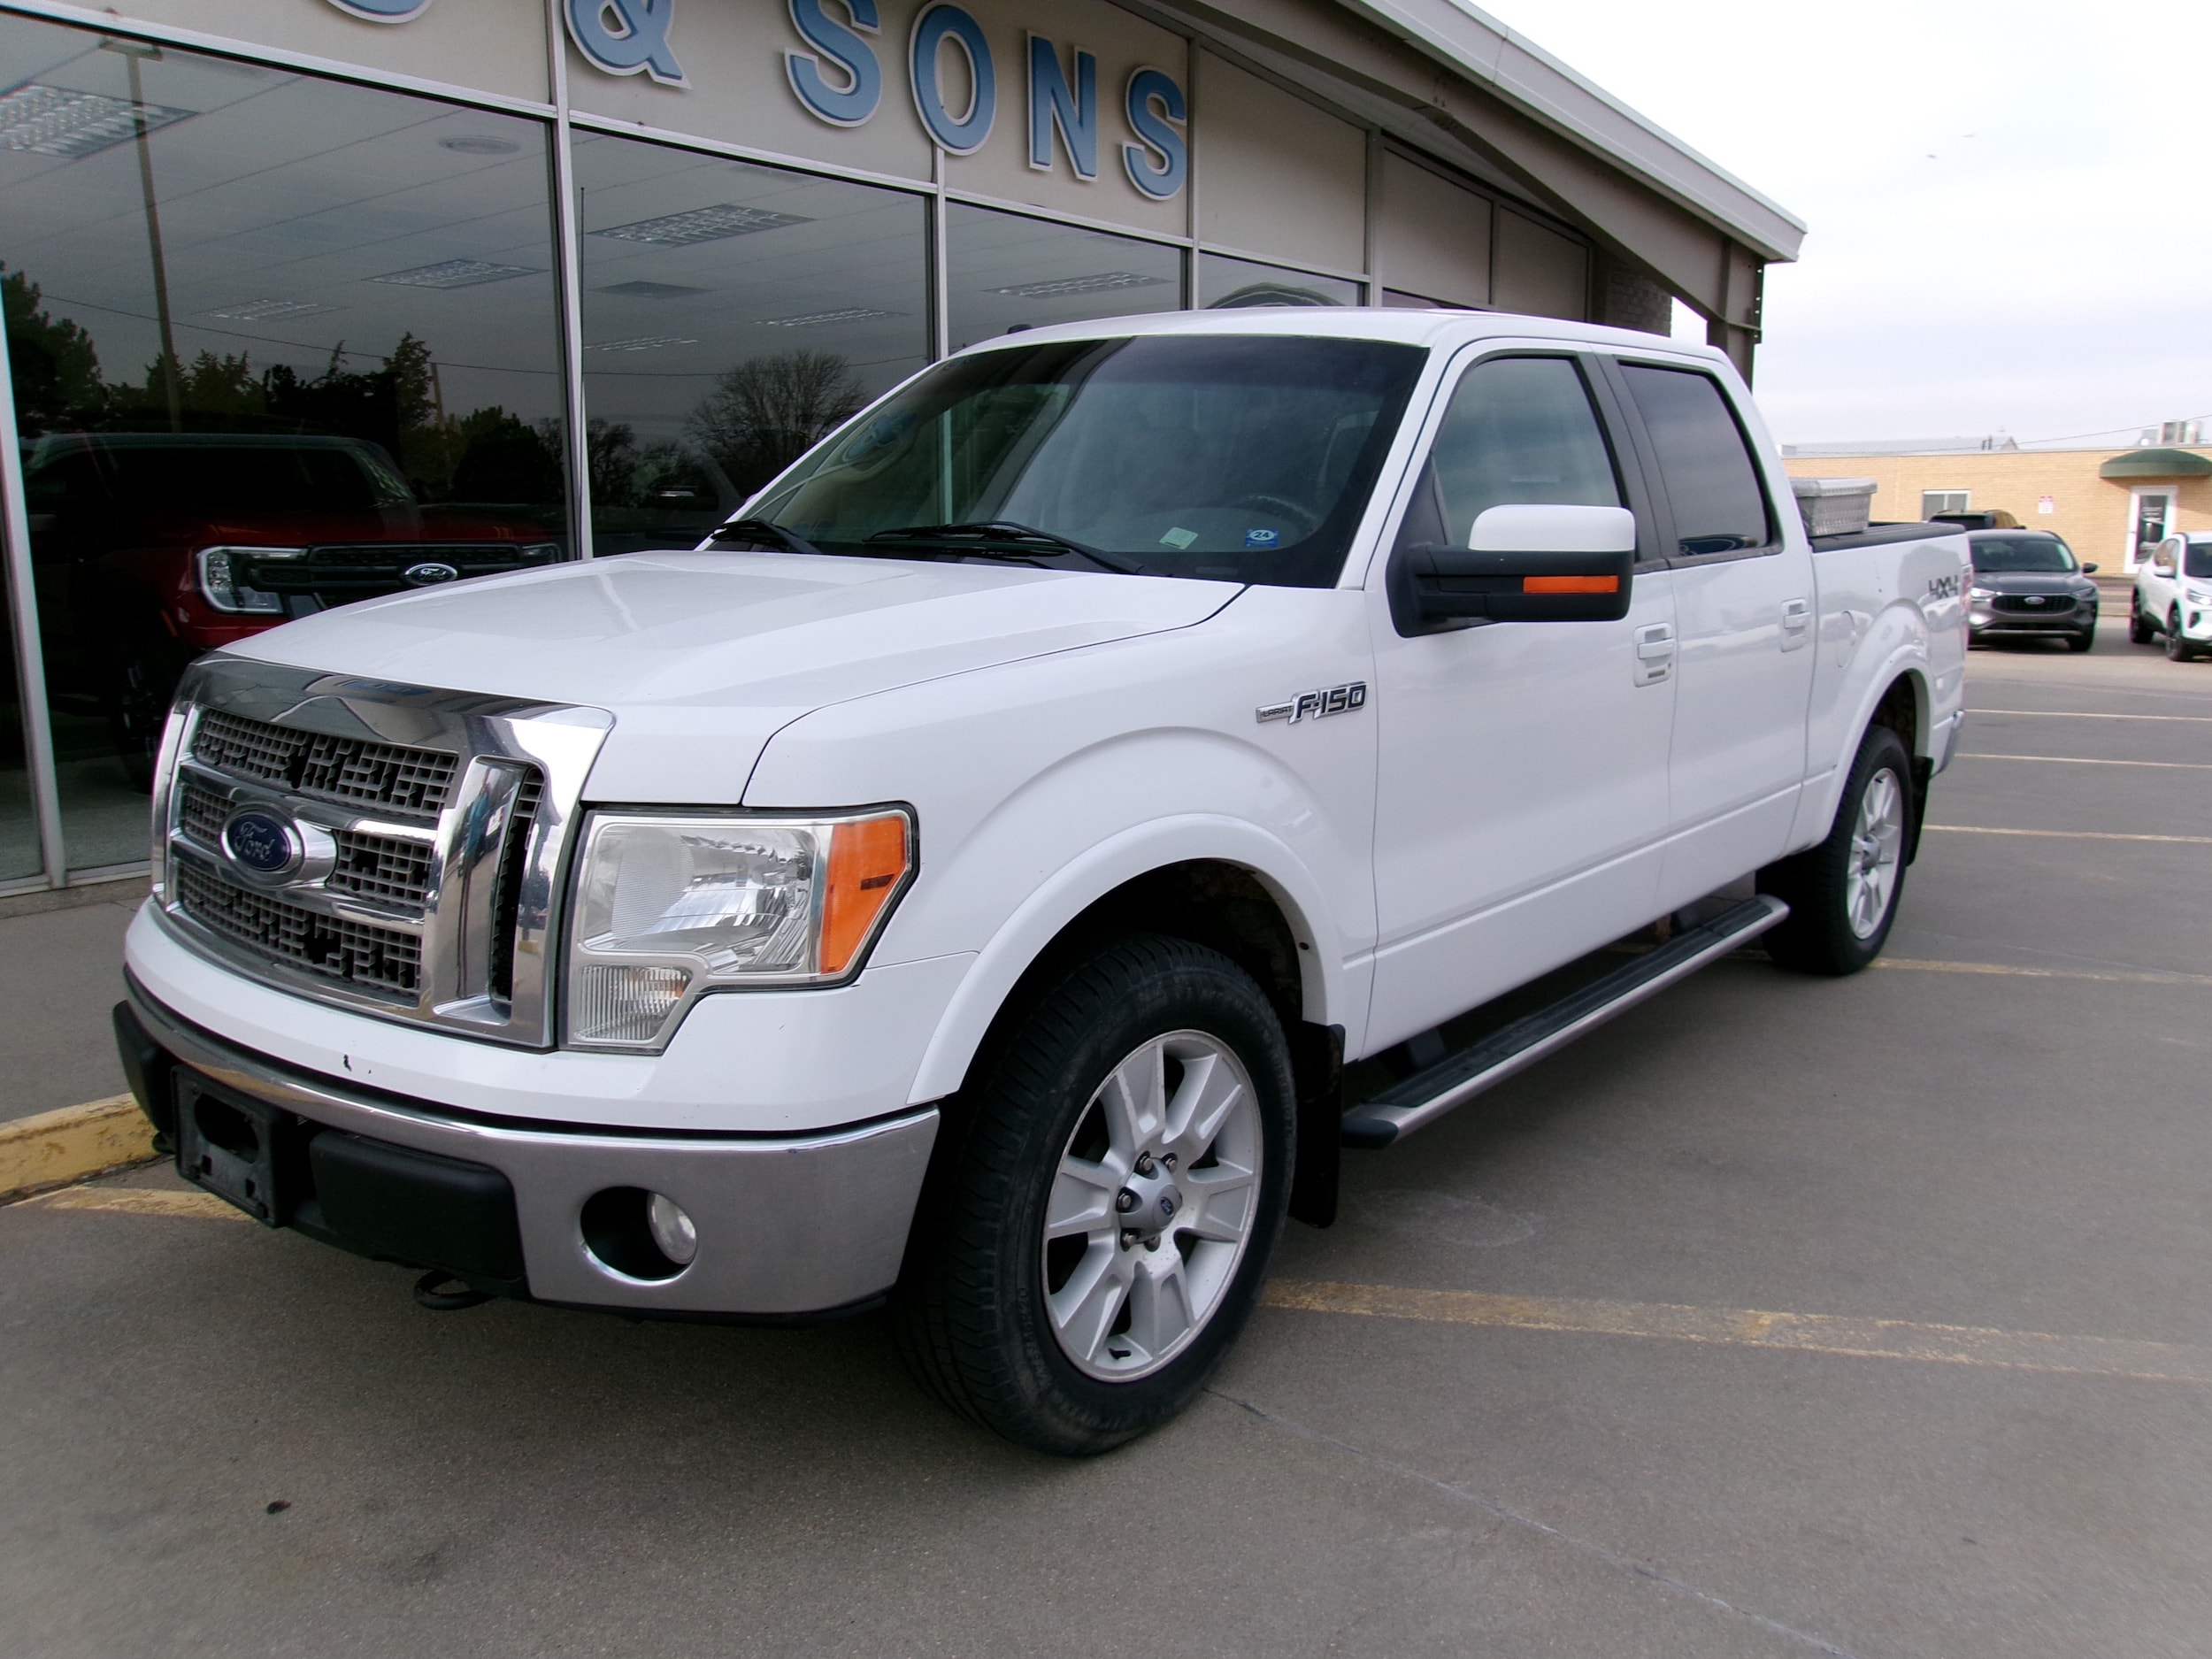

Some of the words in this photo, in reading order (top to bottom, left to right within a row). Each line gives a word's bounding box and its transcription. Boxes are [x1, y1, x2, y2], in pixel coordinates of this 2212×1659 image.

[785, 0, 1187, 202] SONS
[419, 566, 447, 581] Ford
[1262, 705, 1294, 718] LARIAT
[234, 821, 276, 862] Ford
